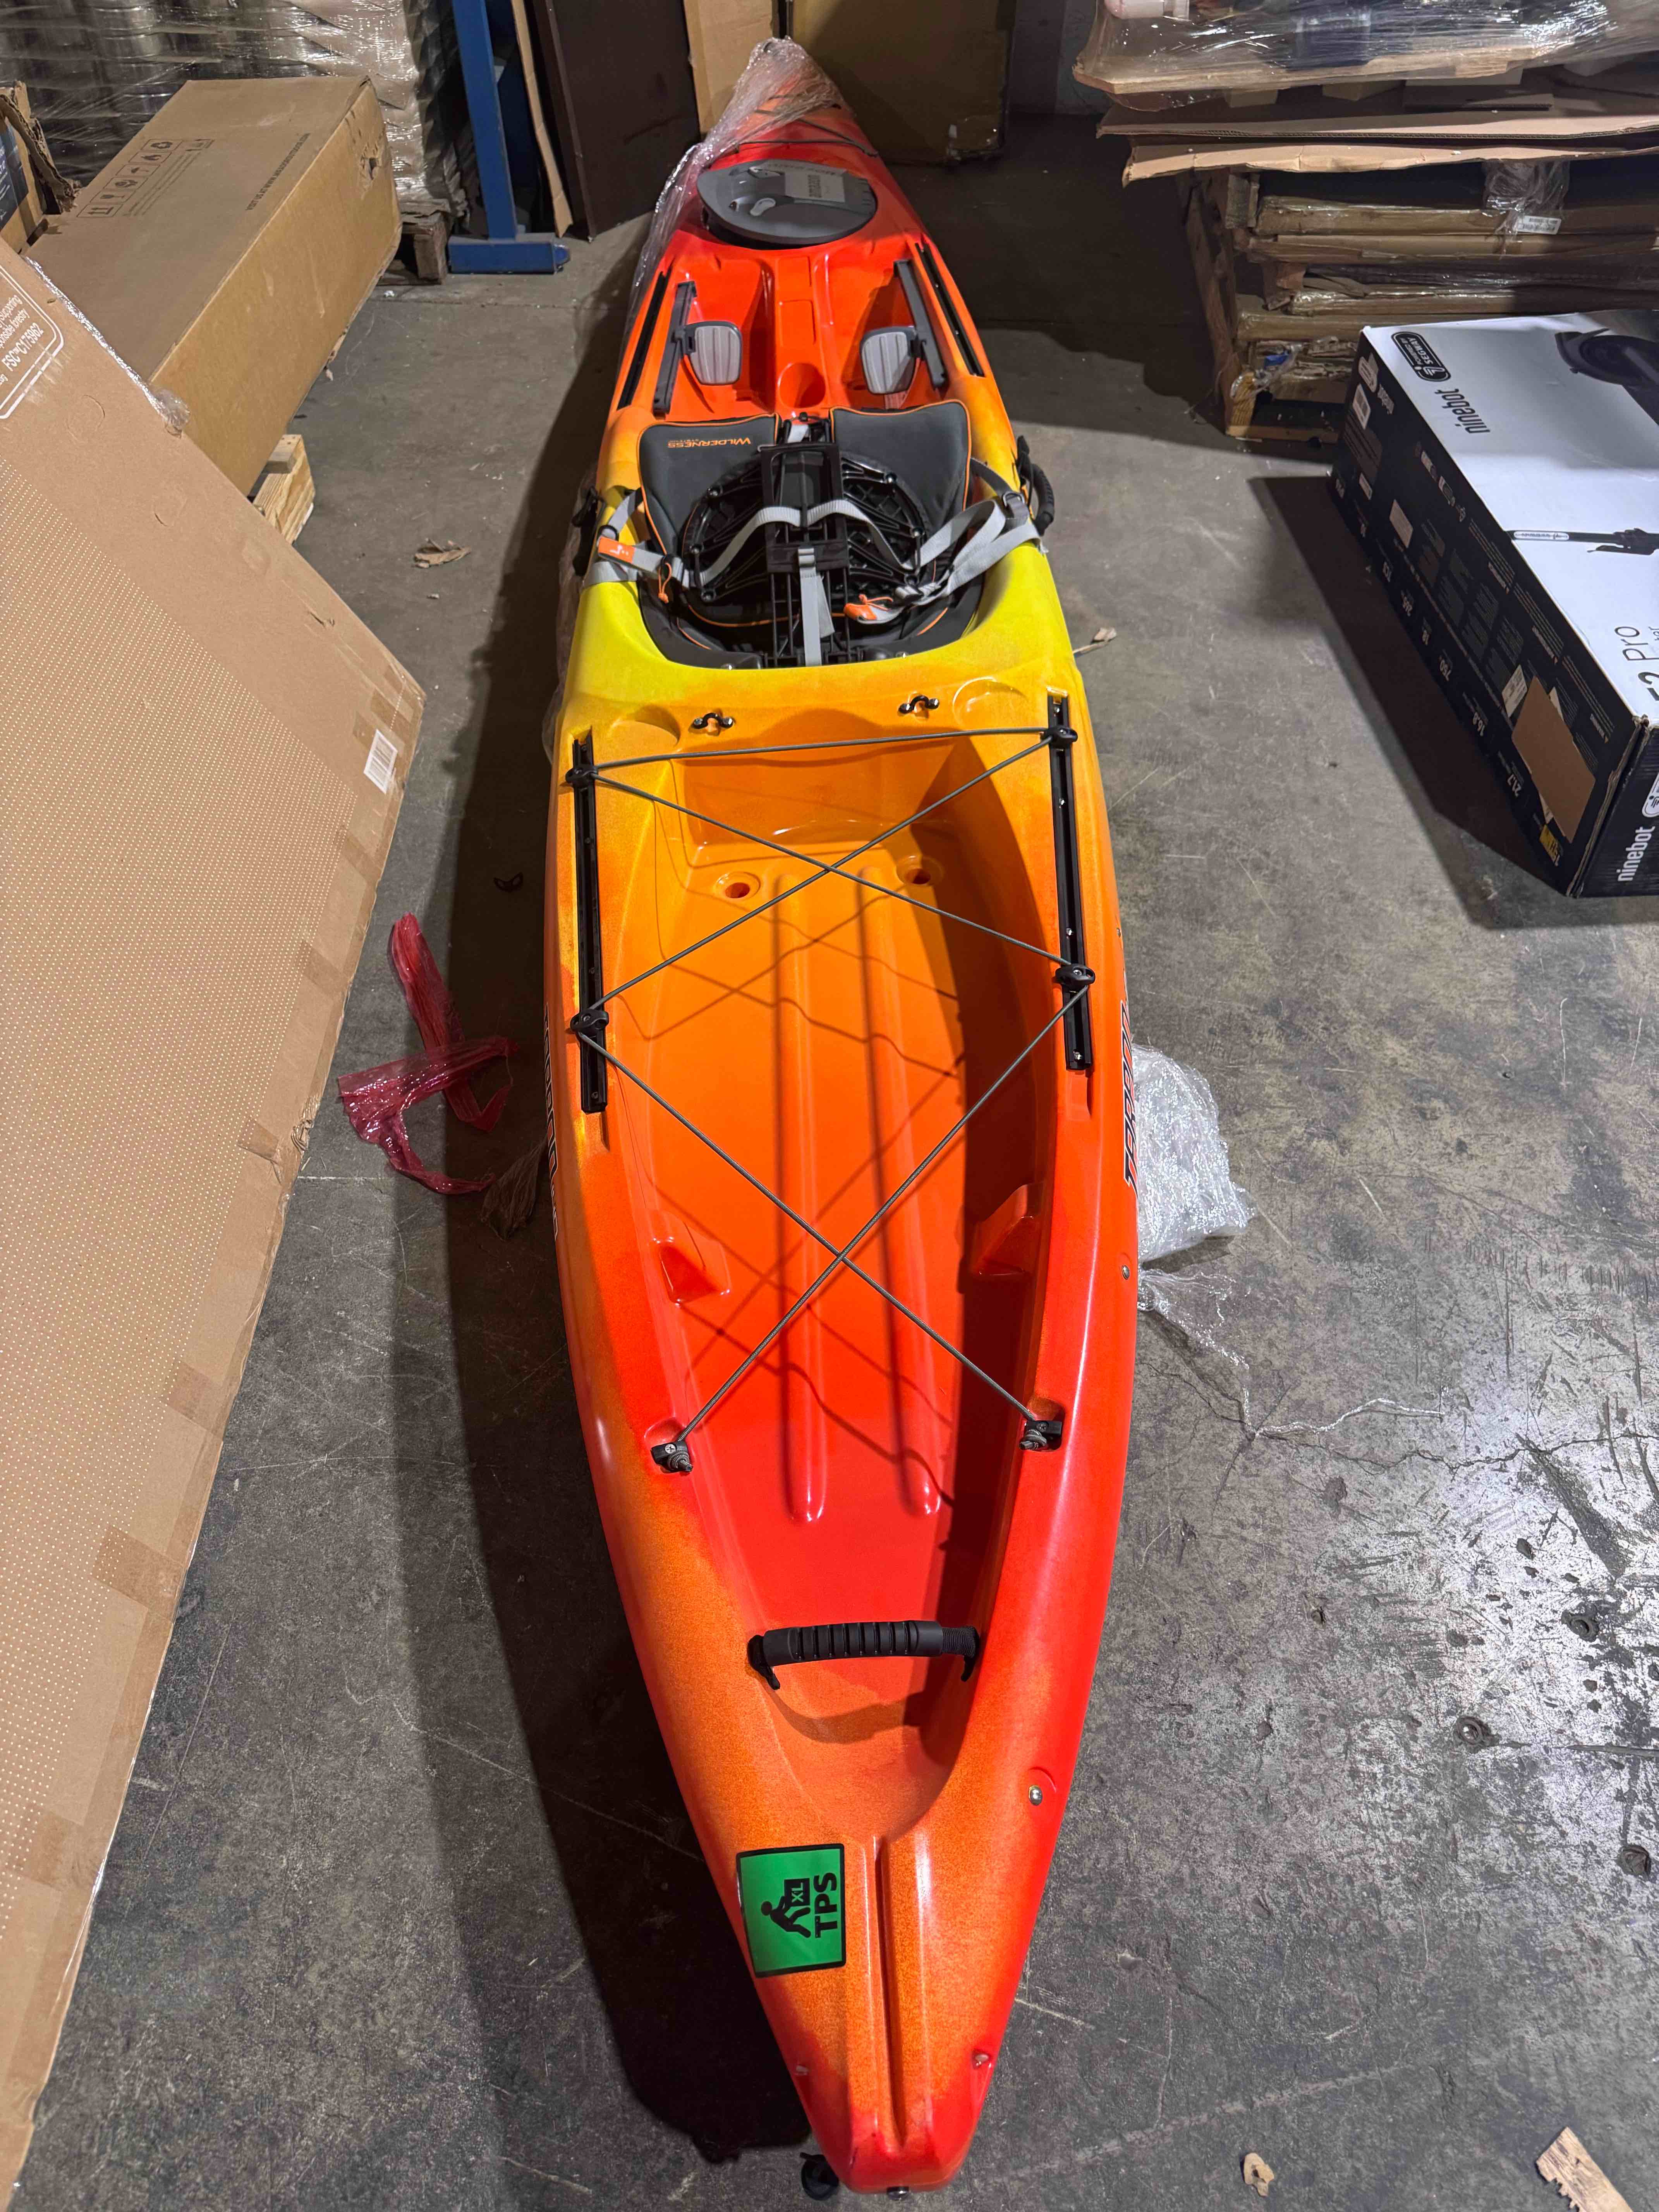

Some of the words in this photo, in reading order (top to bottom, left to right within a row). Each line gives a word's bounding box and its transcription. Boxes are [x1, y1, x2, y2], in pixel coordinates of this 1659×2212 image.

[1408, 337, 1433, 365] SEGWAY
[1434, 388, 1490, 434] ninebot
[667, 437, 751, 448] WILDERNESS
[1614, 626, 1659, 661] Pro
[1616, 826, 1656, 881] ninebot
[791, 1882, 804, 1903] XL
[814, 1872, 837, 1938] TPS
